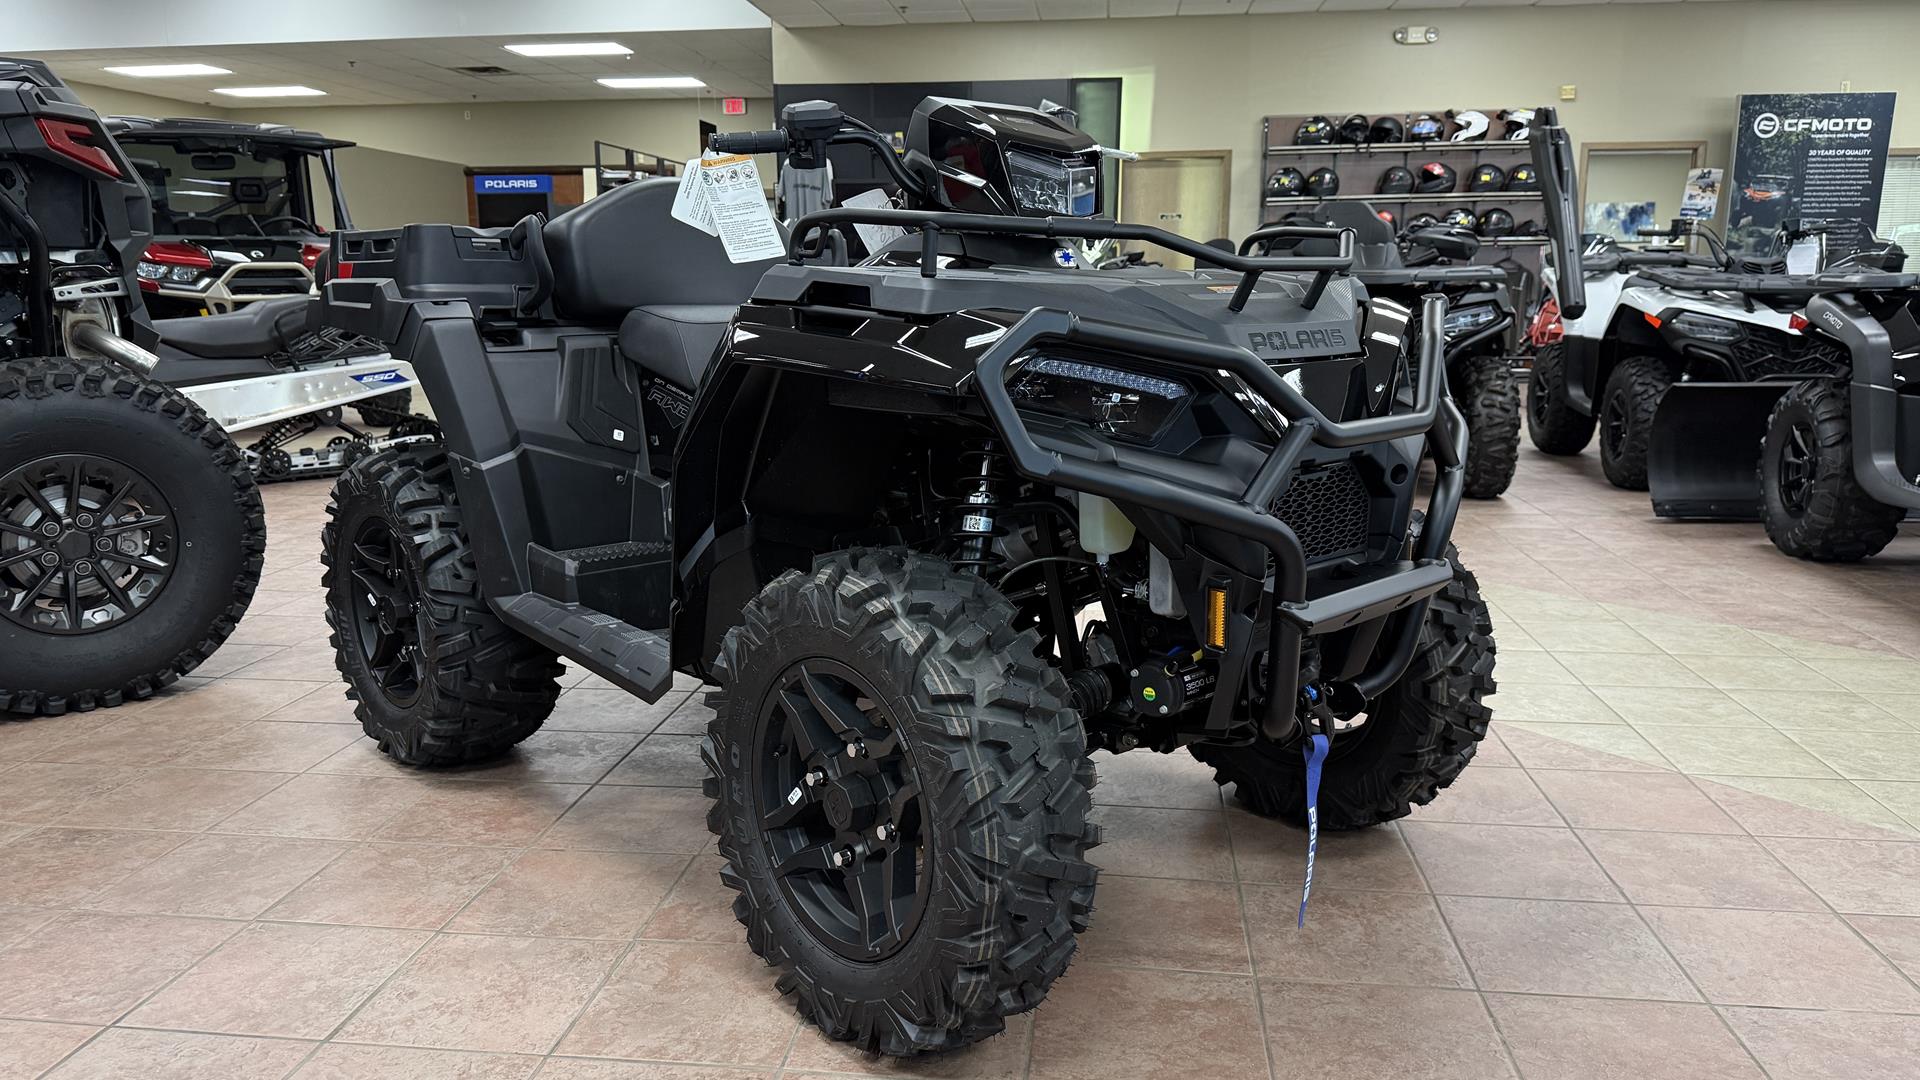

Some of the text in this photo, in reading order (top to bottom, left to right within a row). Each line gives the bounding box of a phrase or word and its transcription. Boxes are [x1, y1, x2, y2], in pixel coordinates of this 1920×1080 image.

[1783, 117, 1873, 132] CFMOTO
[484, 179, 538, 189] POLARIS
[1823, 311, 1843, 330] CFMOTO
[1247, 328, 1347, 352] POLARIS
[1185, 677, 1205, 692] 3500
[1303, 806, 1318, 903] POLARIS
